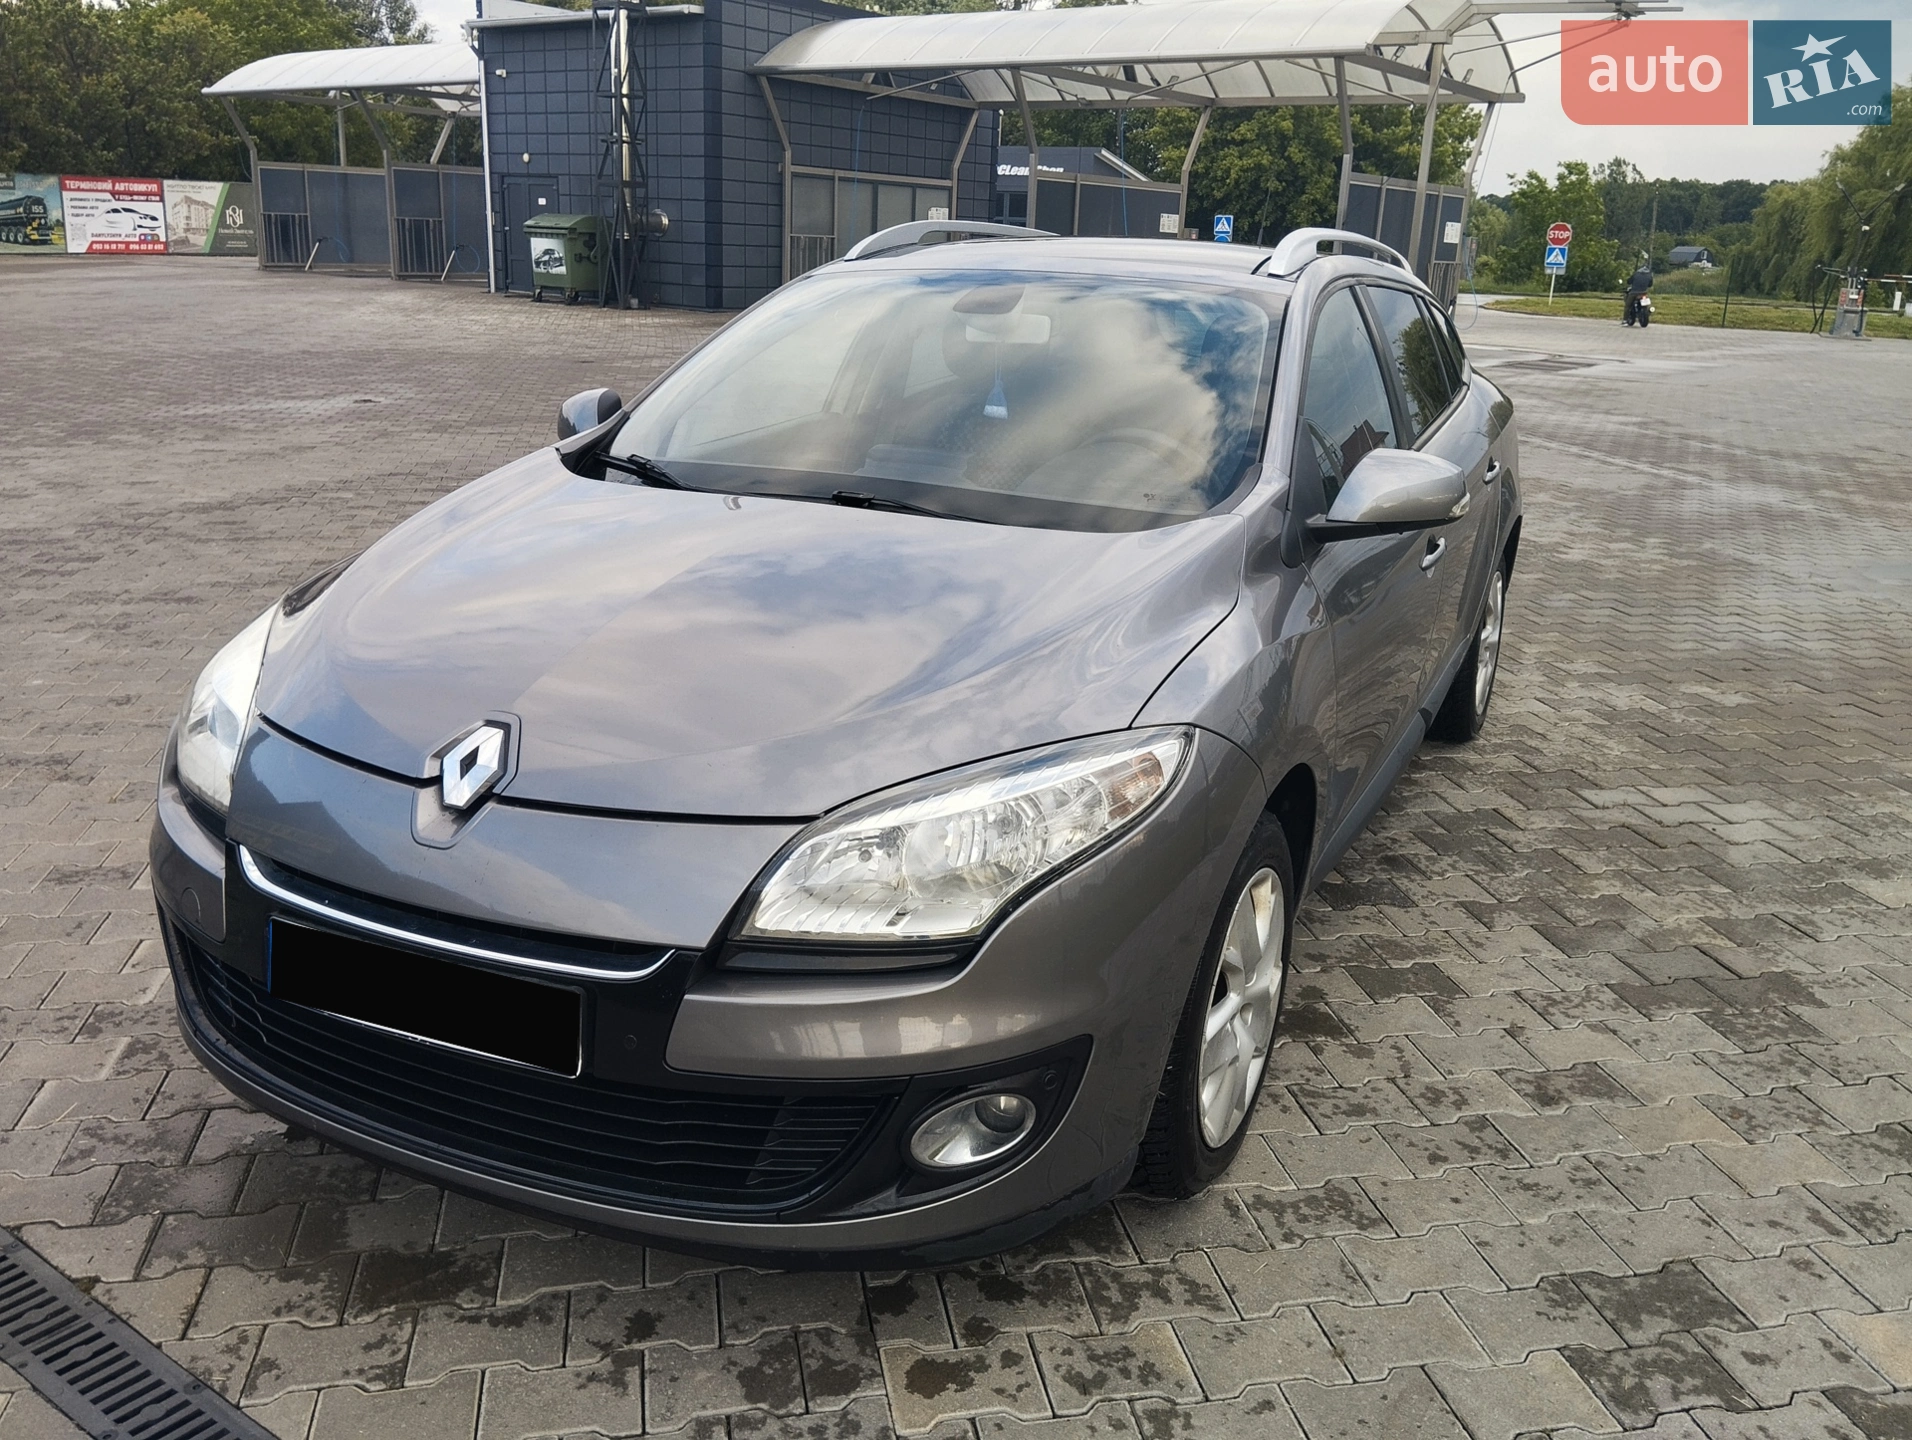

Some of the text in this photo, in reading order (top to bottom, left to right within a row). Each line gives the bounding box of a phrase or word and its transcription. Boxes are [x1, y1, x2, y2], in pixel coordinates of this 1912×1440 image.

[65, 180, 113, 191] ТЕРМІНОВИЙ
[115, 182, 158, 192] АВТОВИКУП
[32, 205, 44, 213] ISS
[1549, 230, 1570, 239] STOP
